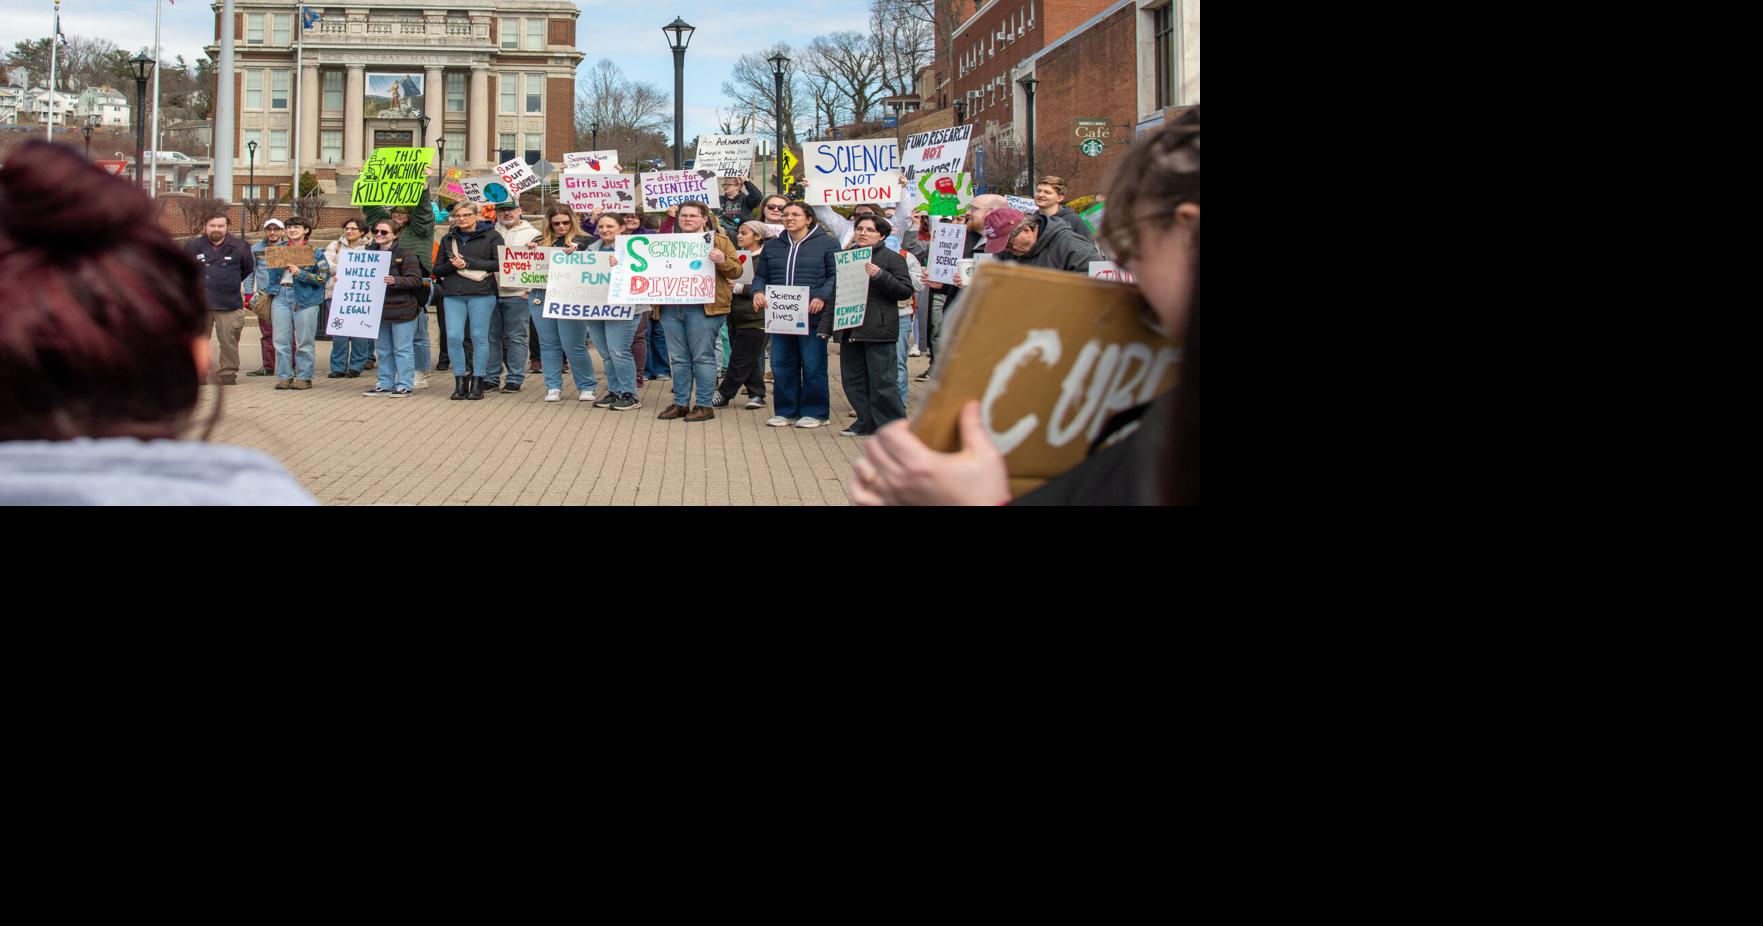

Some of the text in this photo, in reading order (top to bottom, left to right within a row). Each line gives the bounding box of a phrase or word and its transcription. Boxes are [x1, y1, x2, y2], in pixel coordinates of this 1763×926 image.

[905, 125, 970, 150] FUND RESEARCH
[1075, 126, 1110, 138] Café
[394, 149, 421, 162] THIS
[814, 144, 899, 174] SCIENCE
[922, 145, 944, 160] NOT
[381, 162, 428, 180] MACHINE
[682, 171, 697, 181] for
[565, 175, 630, 189] Girls just
[844, 173, 876, 187] NOT
[354, 182, 387, 203] KILLS
[645, 180, 708, 195] SCIENTIFIC
[823, 185, 891, 203] FICTION
[567, 200, 594, 210] have
[659, 194, 710, 208] RESEARCH
[939, 241, 952, 249] STAND
[348, 252, 380, 263] THINK
[505, 248, 545, 260] America
[552, 252, 596, 265] GIRLS
[626, 236, 710, 273] SCIENCE
[836, 248, 871, 264] WE NEED
[935, 255, 958, 267] SCIENCE
[345, 267, 376, 277] WHILE
[503, 260, 531, 275] great
[343, 292, 371, 302] STILL
[770, 290, 801, 301] Science
[548, 302, 631, 318] RESEARCH
[772, 312, 794, 321] lives
